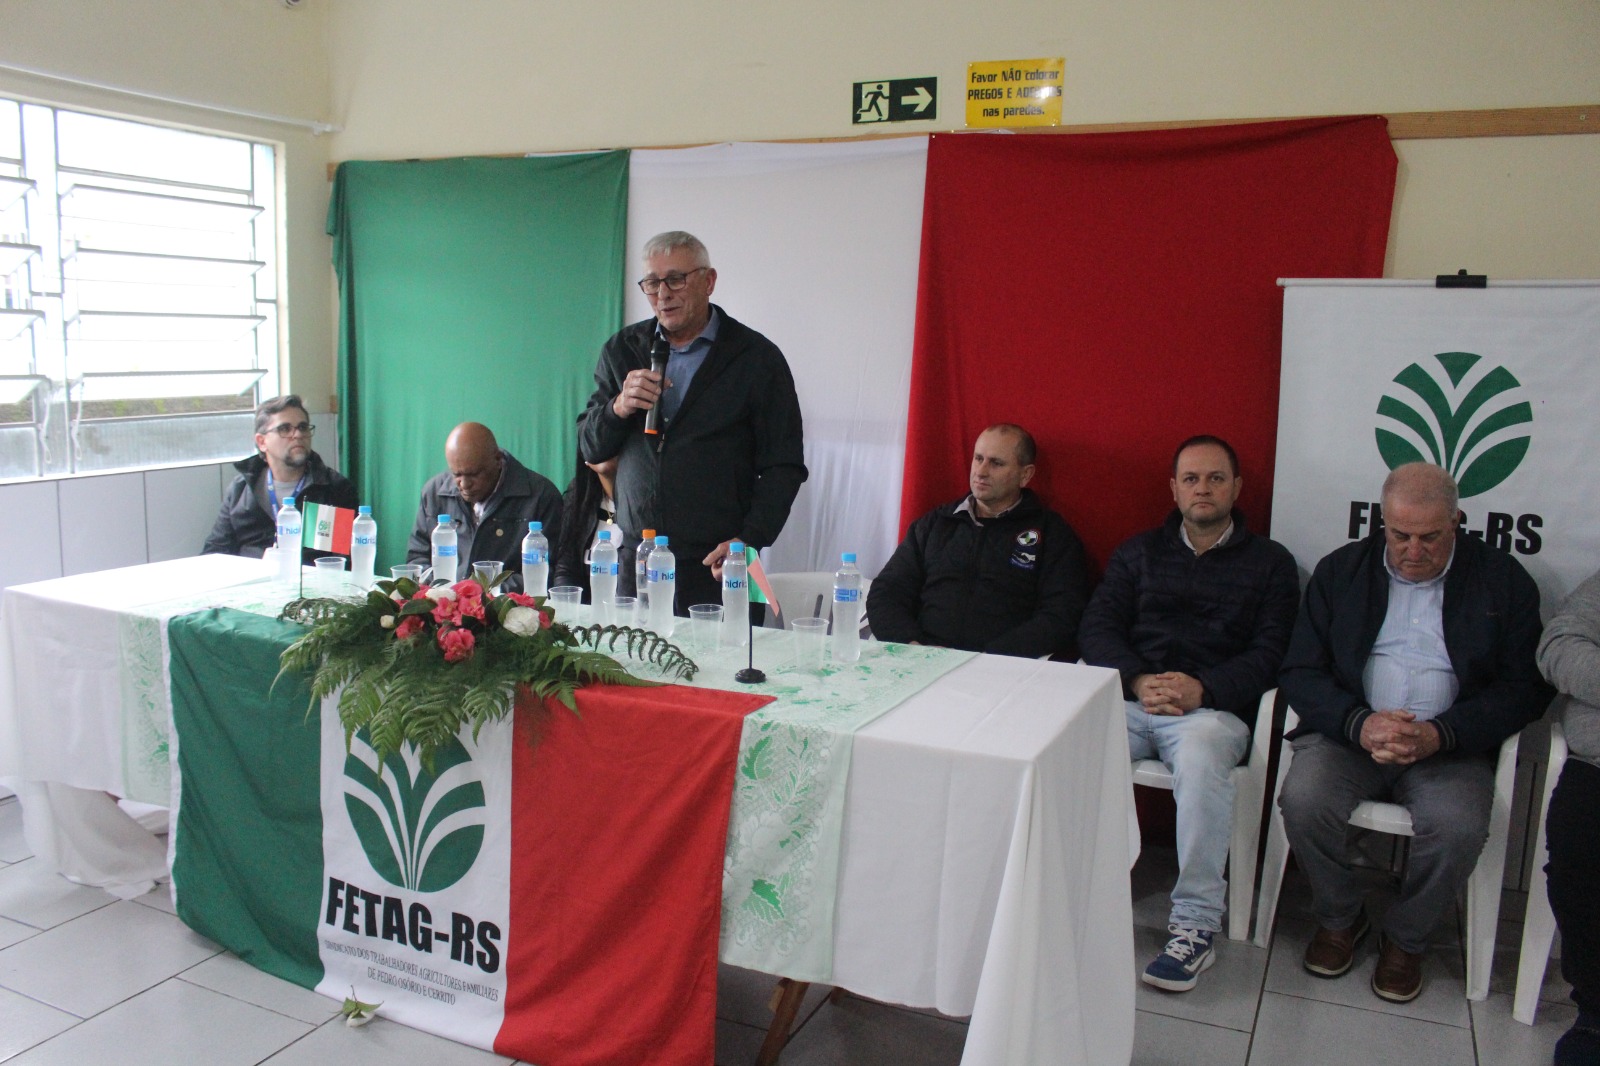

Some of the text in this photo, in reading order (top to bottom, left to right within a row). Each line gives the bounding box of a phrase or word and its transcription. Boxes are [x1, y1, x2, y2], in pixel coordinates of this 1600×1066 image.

[971, 68, 1060, 83] Favor NÃO colocar
[968, 86, 1062, 100] PREGOS E ADEOS
[982, 104, 1045, 119] nas paredes.
[325, 876, 501, 974] FETAG-RS
[357, 947, 370, 960] DOS
[370, 950, 418, 976] TRABALHADORES
[419, 967, 462, 991] AGRICULTORES
[462, 981, 499, 1002] FAMILIARES
[367, 966, 456, 1005] DE PEDRO OSÓRIO E CERRITO
